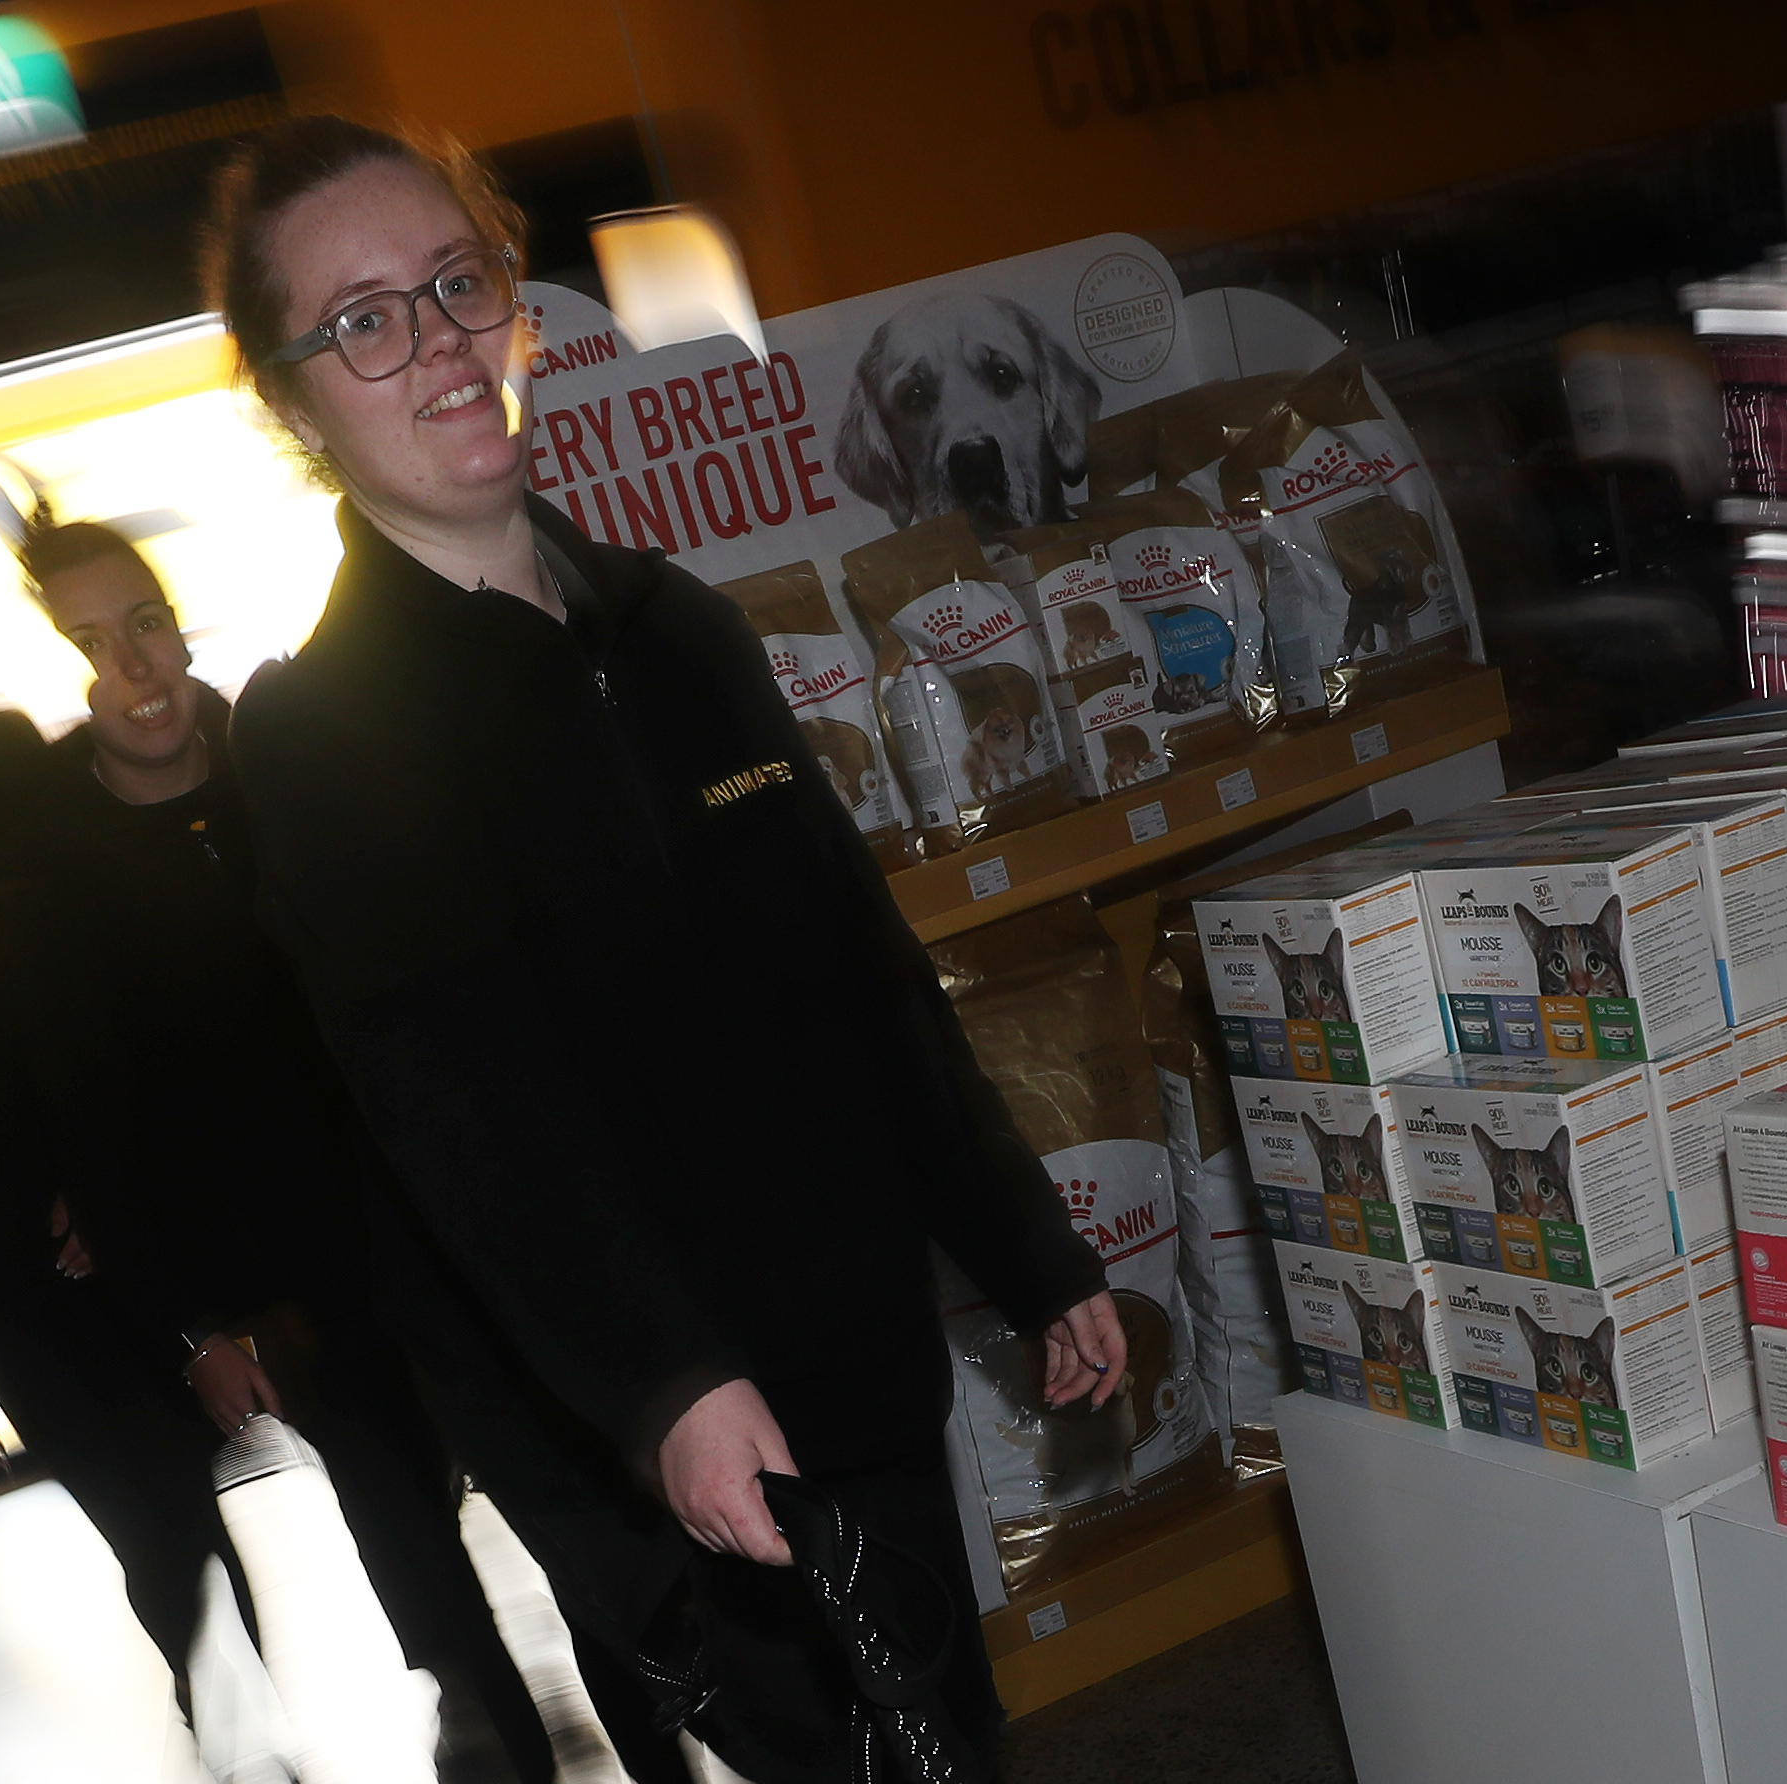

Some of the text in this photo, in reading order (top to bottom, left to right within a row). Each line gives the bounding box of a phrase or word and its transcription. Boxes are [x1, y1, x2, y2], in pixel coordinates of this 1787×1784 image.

[1083, 296, 1165, 332] DESIGNED
[529, 329, 618, 379] CANIN
[627, 352, 805, 461] BREED
[565, 425, 836, 555] UNIQUE
[1048, 576, 1107, 603] ROYAL CANIN
[1118, 571, 1162, 595] ROYAL
[956, 609, 1012, 650] CANIN
[1158, 619, 1214, 642] Miniature
[790, 664, 846, 697] CANIN
[1089, 699, 1147, 727] ROYAL CANIN
[701, 761, 794, 808] ANIMATES
[1533, 883, 1552, 898] 90%
[1441, 905, 1509, 919] LEAPS BOUNDS
[1461, 937, 1504, 951] MOUSSE
[1223, 963, 1256, 976] MOUSSE
[1405, 1119, 1467, 1136] LEAPS BOUNDS
[1263, 1137, 1295, 1151] MOUSSE
[1423, 1151, 1463, 1166] MOUSSE
[1079, 1201, 1157, 1252] CANIN
[1448, 1295, 1511, 1317] LEAPS BOUNDS
[1465, 1326, 1504, 1344] MOUSSE
